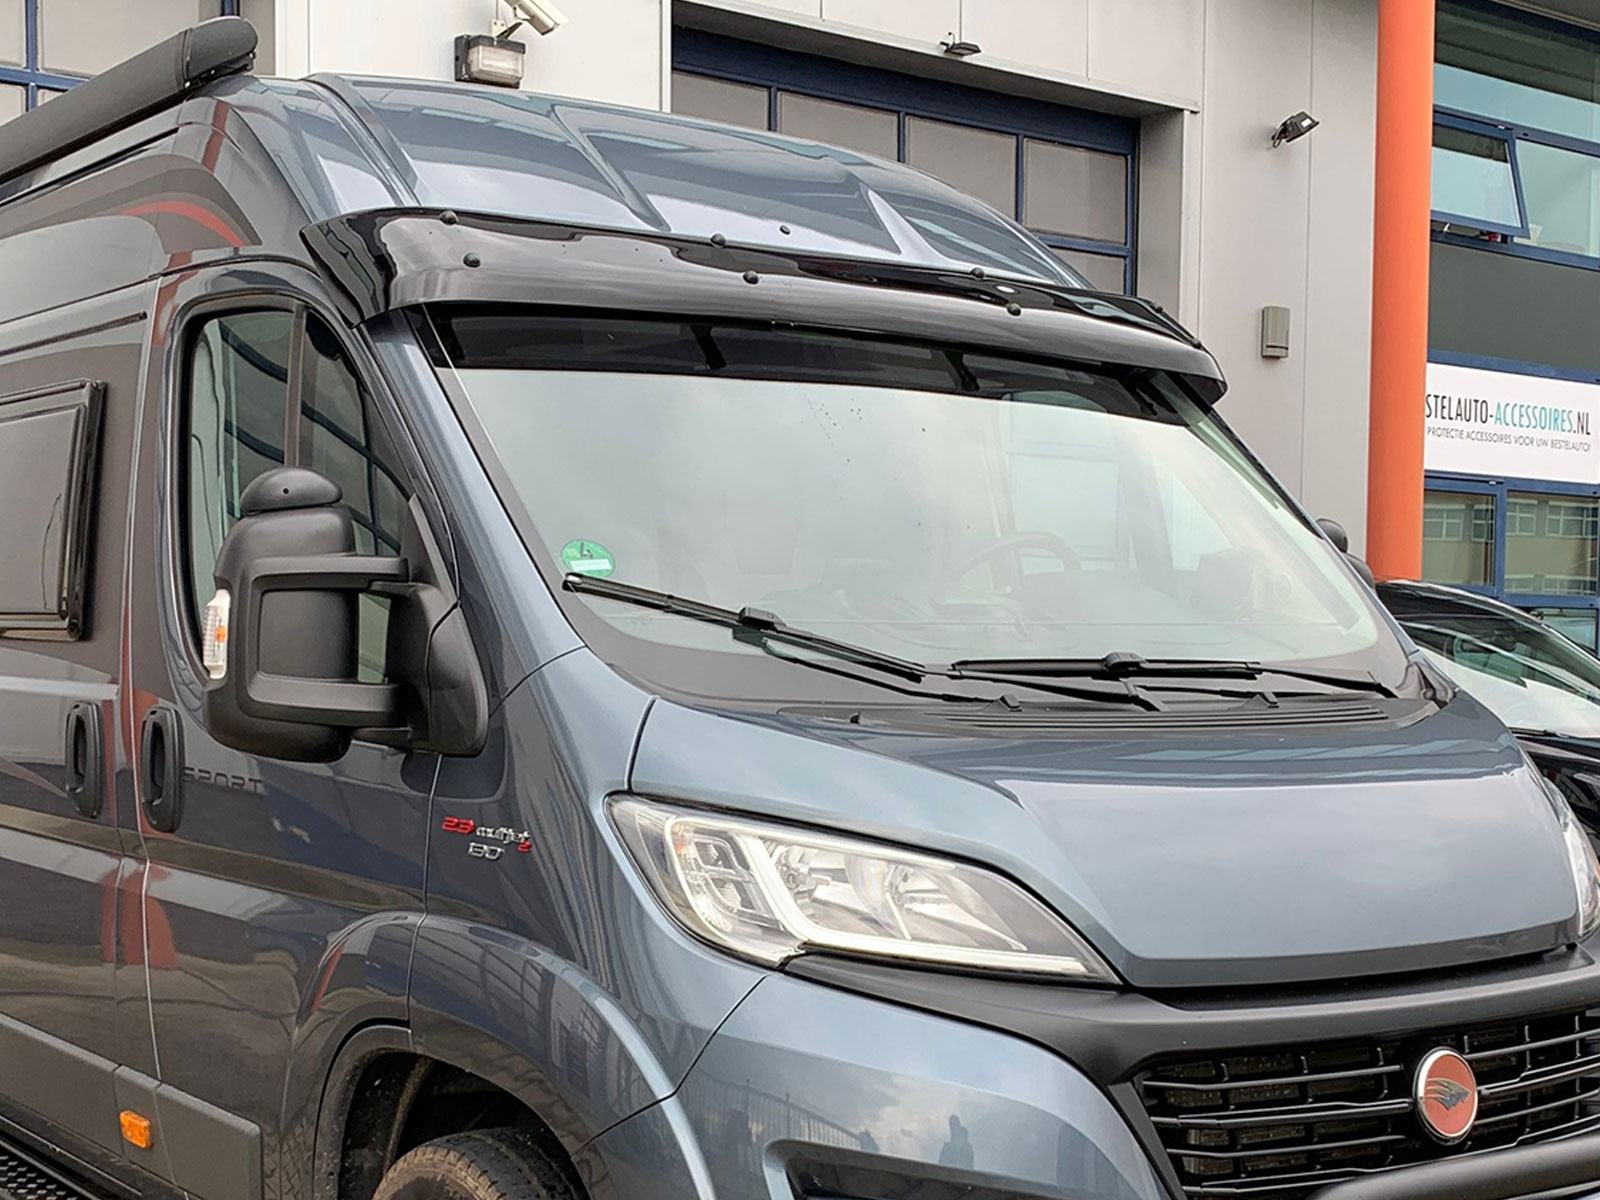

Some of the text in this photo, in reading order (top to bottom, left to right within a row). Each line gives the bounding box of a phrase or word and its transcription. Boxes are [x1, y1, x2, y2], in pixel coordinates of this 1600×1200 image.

[1427, 427, 1464, 440] PROTECTIE
[1465, 431, 1512, 445] ACCESSOIRES
[1513, 435, 1534, 447] VOOR
[1536, 438, 1549, 448] UW
